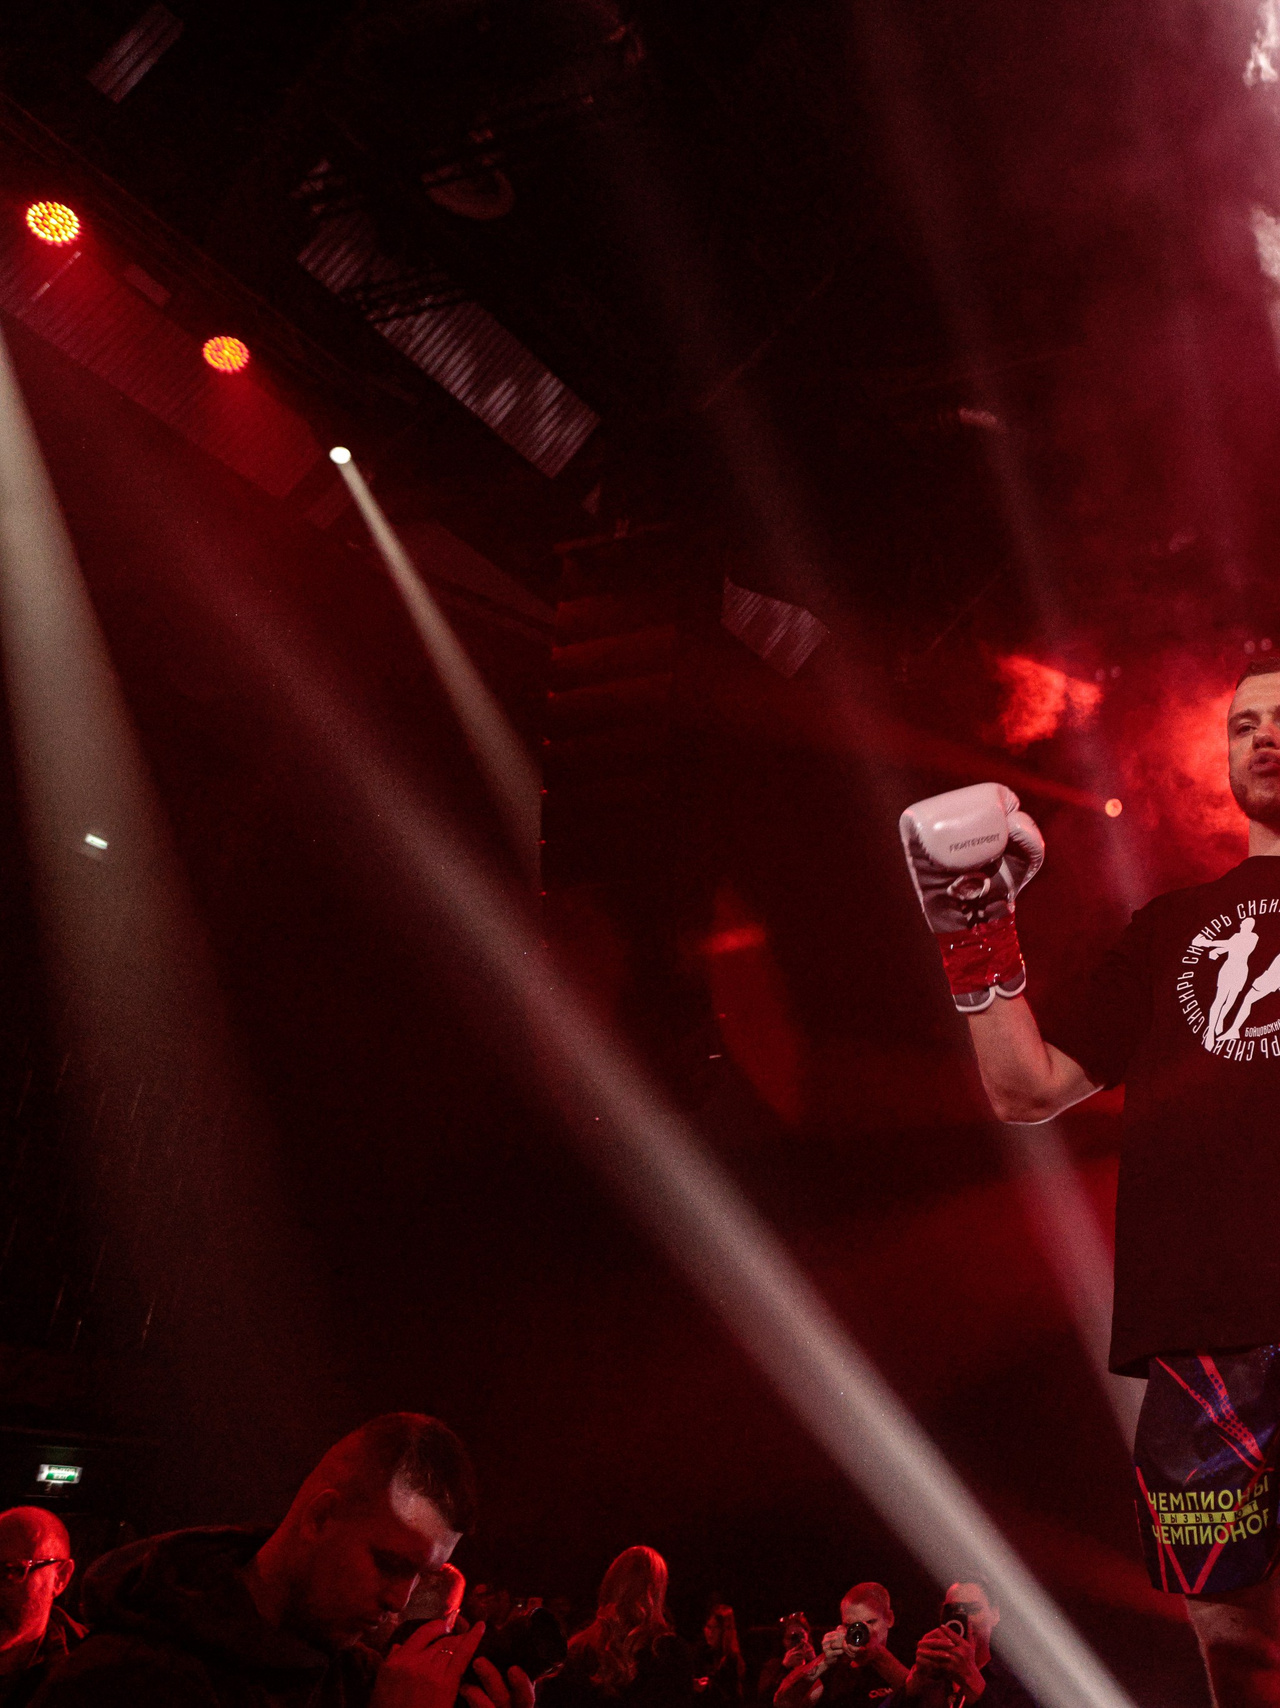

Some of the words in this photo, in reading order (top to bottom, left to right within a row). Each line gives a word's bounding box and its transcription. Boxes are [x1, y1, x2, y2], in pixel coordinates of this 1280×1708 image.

[1181, 914, 1233, 965] СИИРЬ
[1176, 971, 1206, 1034] СИБИРЬ
[1147, 1475, 1269, 1512] ЧЕМПИОНЫ
[1160, 1501, 1257, 1524] ВЫЗЫВАЮТ
